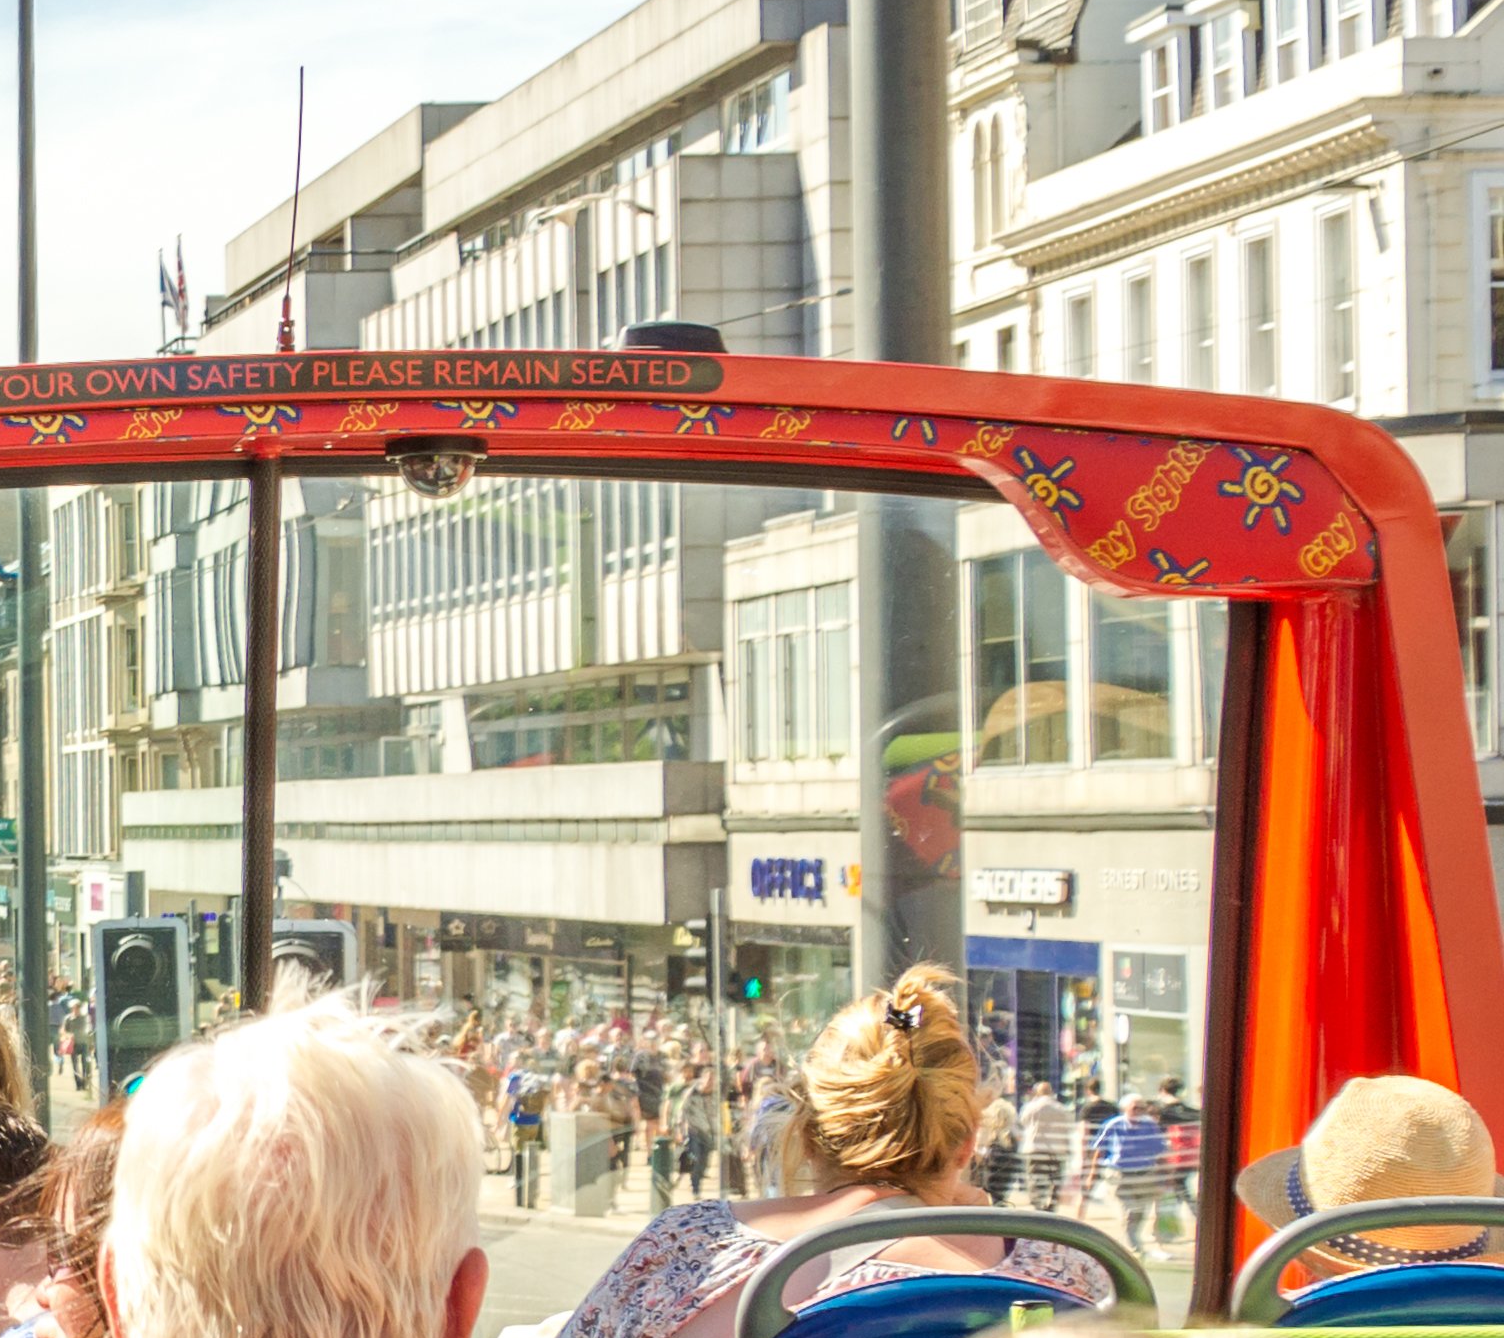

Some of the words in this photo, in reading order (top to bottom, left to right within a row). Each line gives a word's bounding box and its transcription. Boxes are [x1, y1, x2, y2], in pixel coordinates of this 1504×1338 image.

[87, 365, 177, 396] OWN
[189, 361, 303, 390] SAFETY
[312, 360, 423, 387] PLEASE
[433, 359, 560, 387] REMAIN
[568, 359, 692, 388] SEATED
[1085, 520, 1137, 571] ity
[1299, 512, 1357, 578] City
[970, 868, 1071, 904] SKECHERS
[1101, 868, 1146, 890] ERNEST
[1152, 868, 1201, 892] JONES
